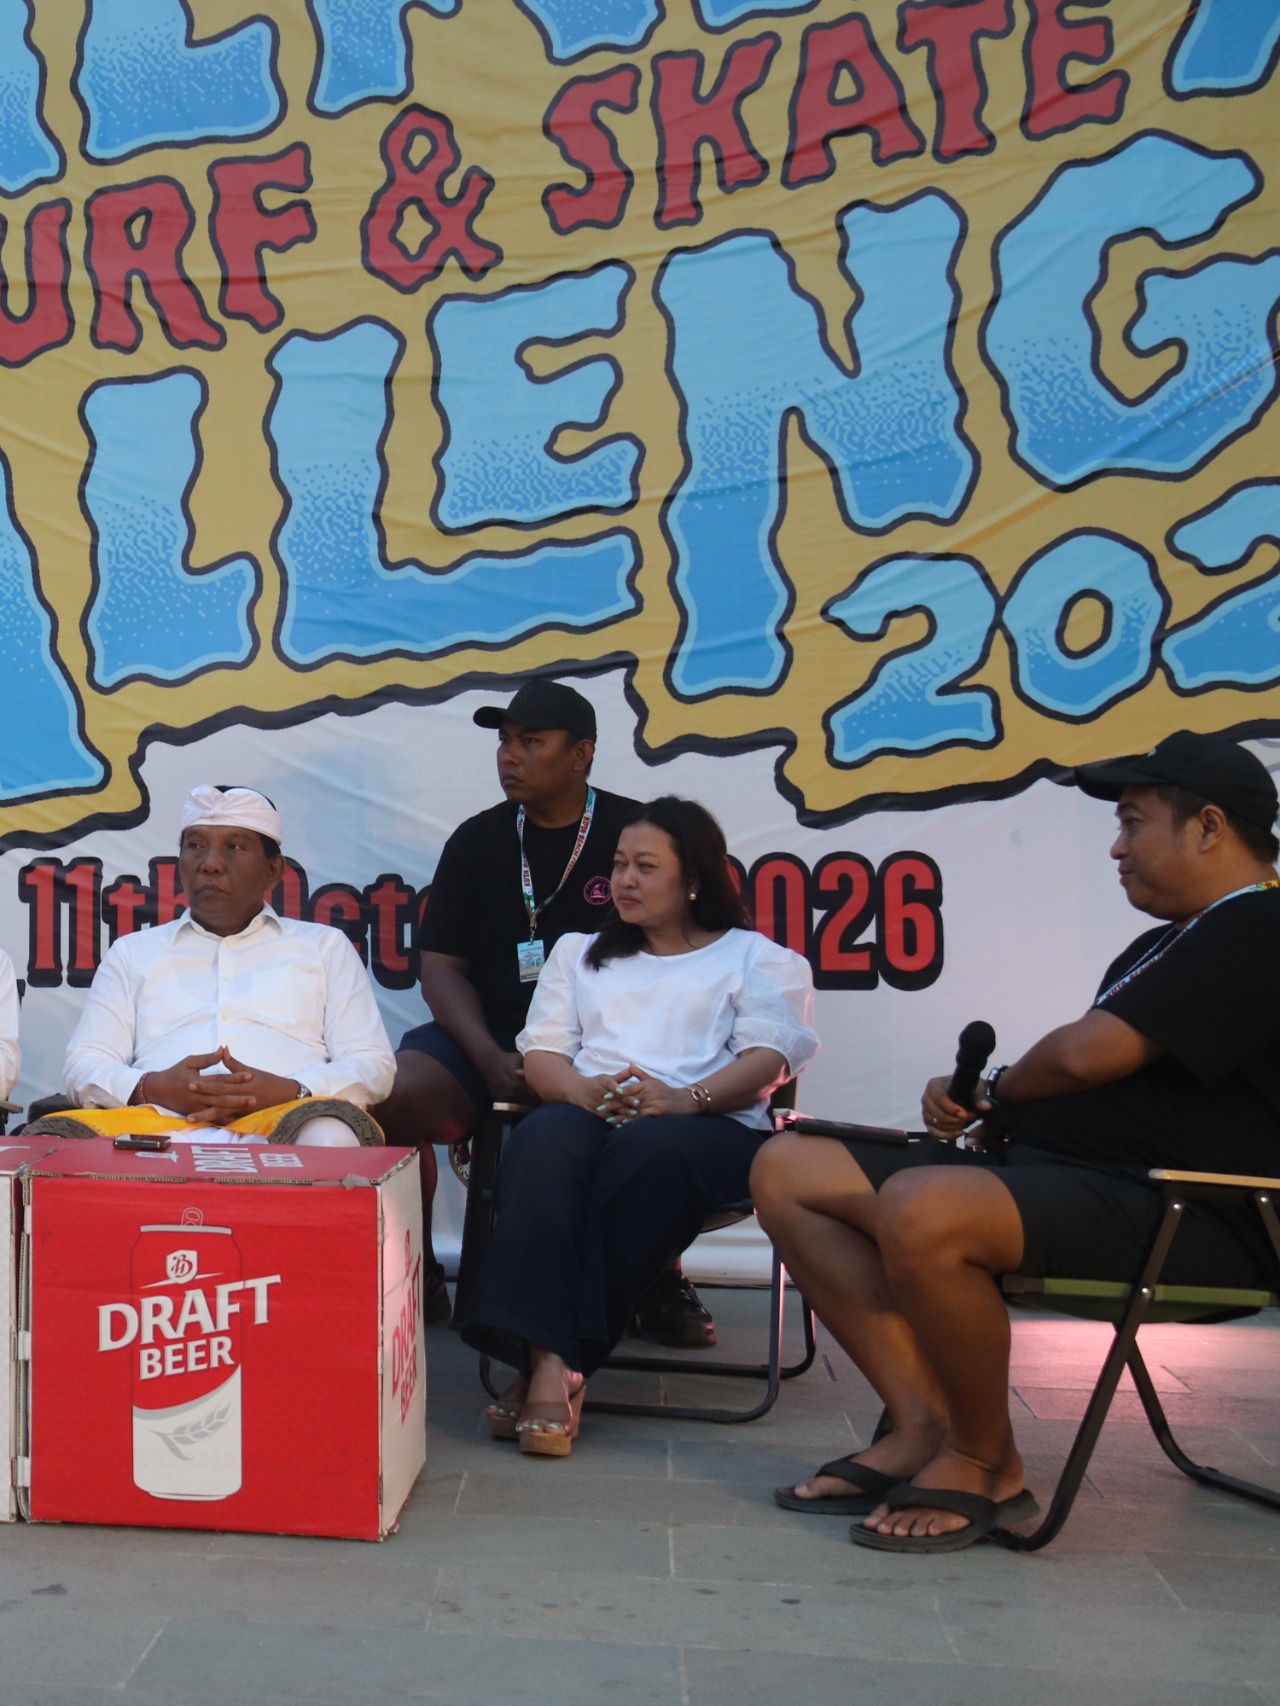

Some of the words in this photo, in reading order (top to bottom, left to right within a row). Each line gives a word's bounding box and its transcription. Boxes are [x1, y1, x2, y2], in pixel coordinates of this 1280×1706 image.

[360, 103, 503, 293] &
[542, 0, 1129, 234] SKATE
[579, 816, 590, 833] KUTA
[523, 869, 532, 887] KUTA
[726, 850, 944, 991] 026
[191, 1145, 258, 1173] DRAFT
[98, 1274, 282, 1352] DRAFT
[392, 1251, 421, 1398] DRAFT
[139, 1336, 236, 1380] BEER
